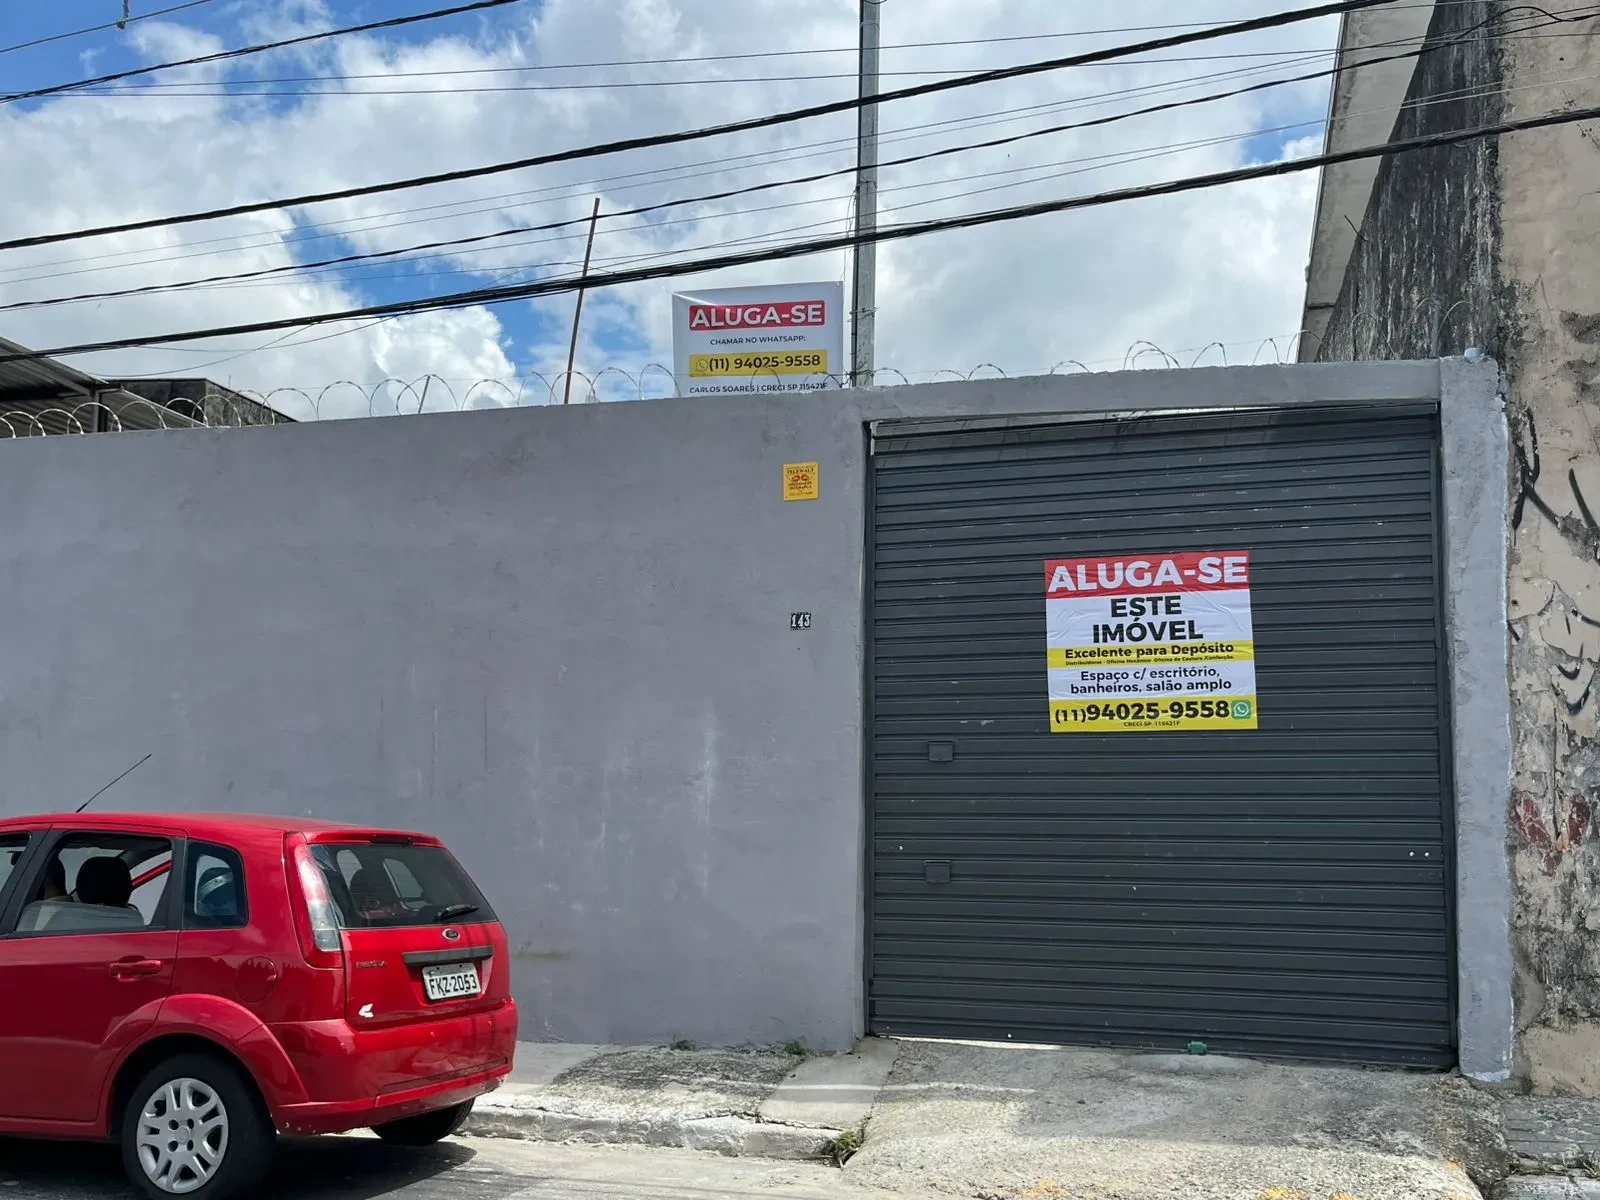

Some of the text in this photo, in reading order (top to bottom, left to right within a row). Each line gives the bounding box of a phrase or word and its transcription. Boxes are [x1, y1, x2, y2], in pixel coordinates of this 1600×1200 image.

[690, 304, 823, 328] ALUGA-SE
[709, 335, 806, 346] CHAMAR NO WHATSAPP:
[709, 355, 821, 372] (11) 94025-9558
[689, 386, 721, 394] CARLOS
[722, 385, 755, 393] SOARES
[761, 384, 785, 392] CRECI
[787, 383, 798, 391] SP
[1047, 556, 1249, 593] ALUGA-SE
[1110, 595, 1182, 618] ESTE
[791, 614, 811, 627] 143
[1092, 615, 1203, 644] IMÓVEL
[1065, 642, 1234, 659] Excelente para Depósito
[1080, 666, 1220, 683] Espaço c/ escritório,
[1070, 679, 1232, 695] banheiros, salão amplo
[1055, 700, 1230, 724] (11)94025-9558
